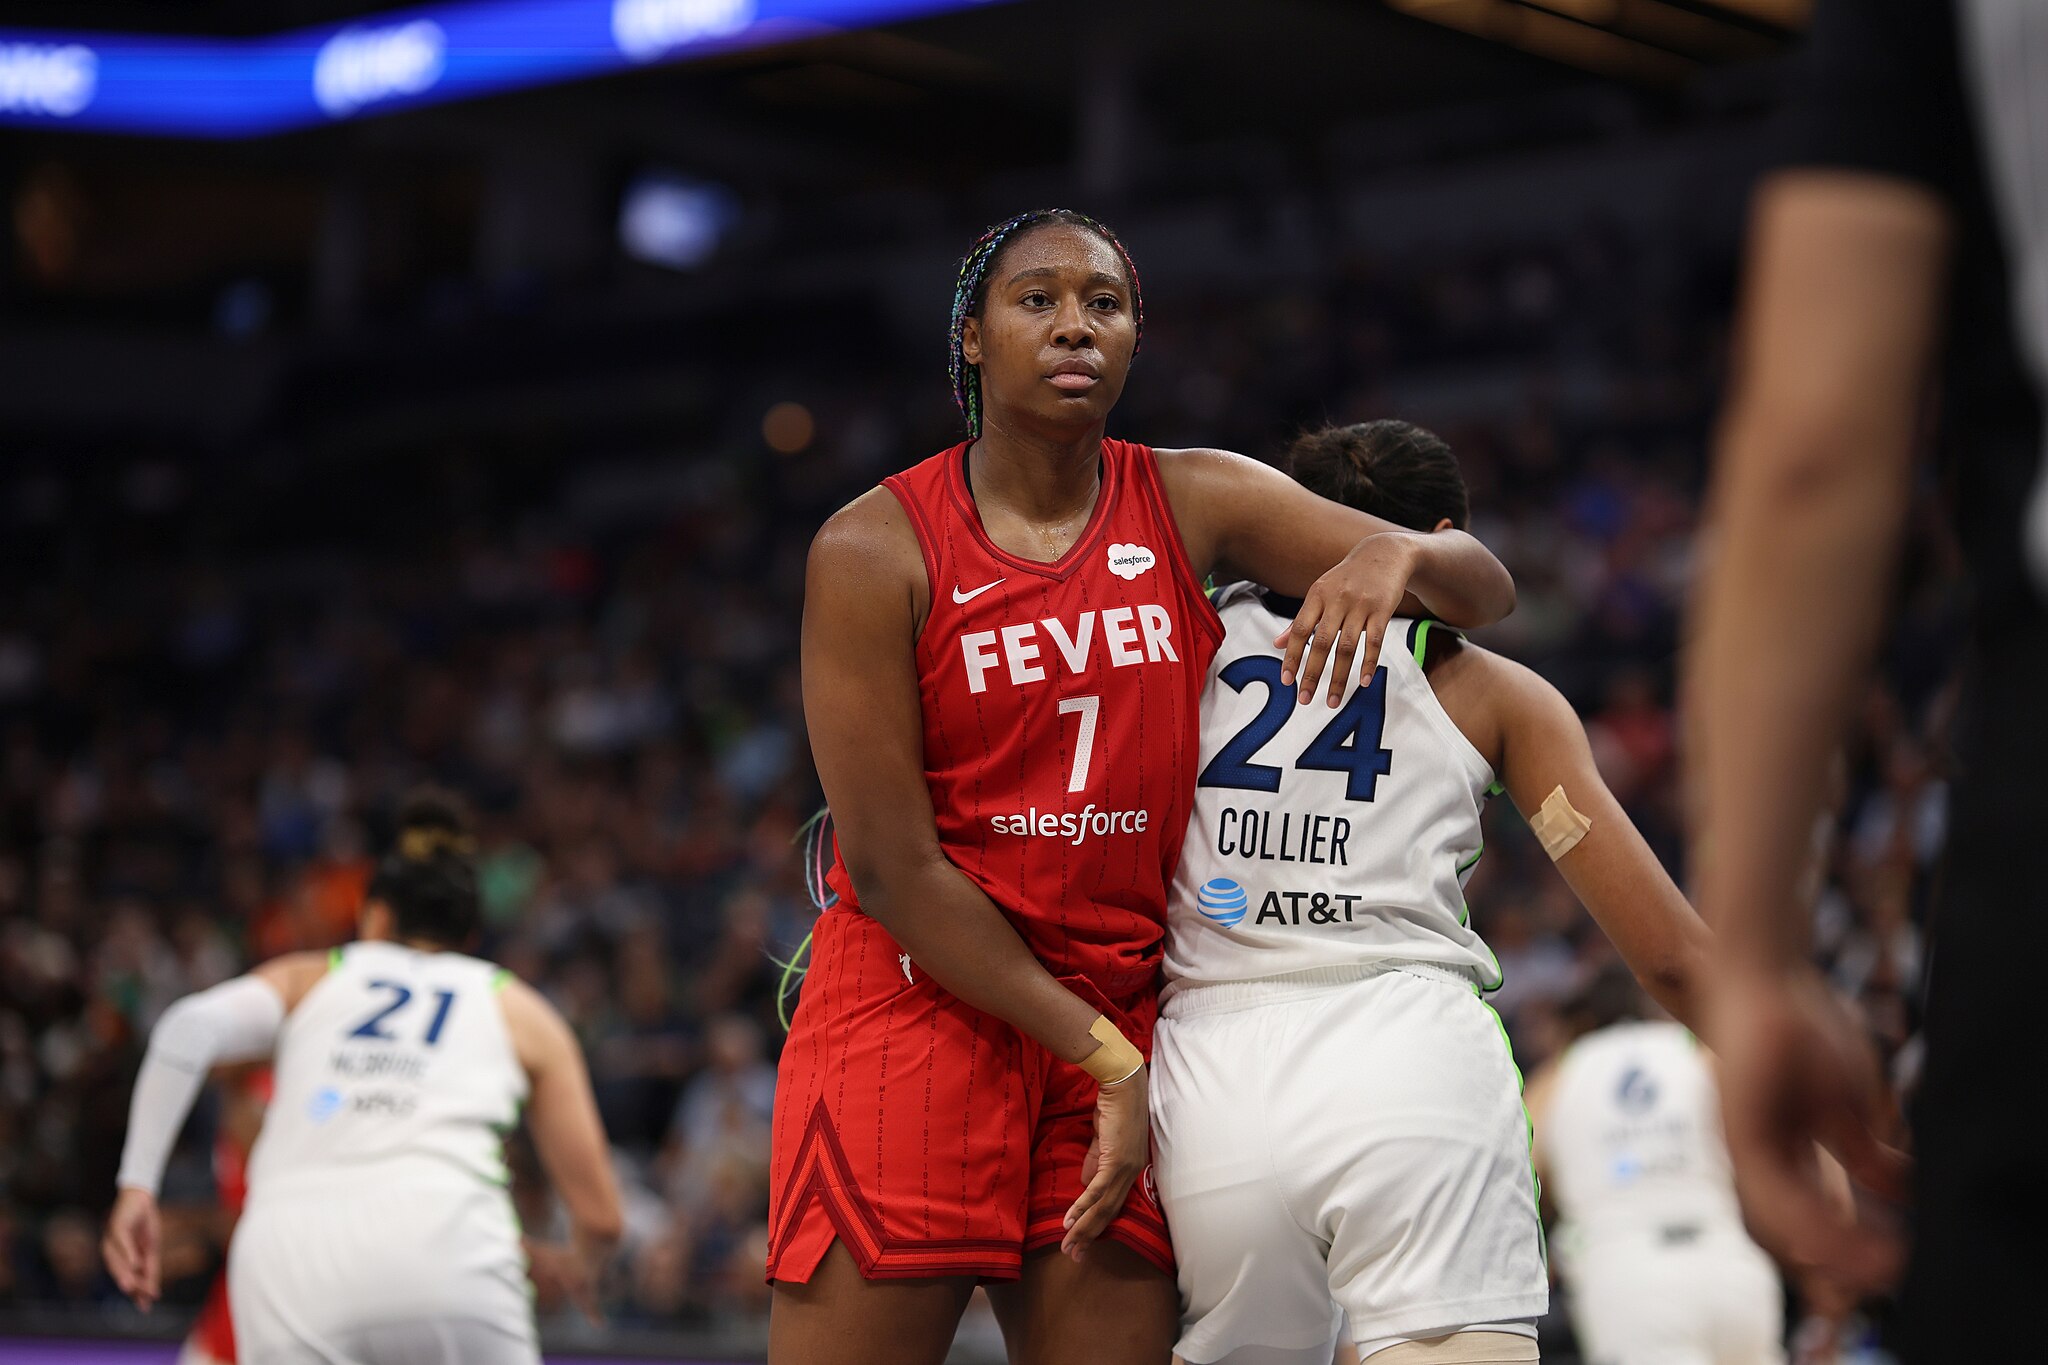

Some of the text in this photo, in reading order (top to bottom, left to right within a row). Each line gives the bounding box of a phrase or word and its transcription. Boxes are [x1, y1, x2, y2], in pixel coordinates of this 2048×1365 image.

[1113, 555, 1151, 567] salesforce
[960, 604, 1180, 694] FEVER
[1057, 693, 1100, 794] 7
[1197, 655, 1393, 803] 24
[990, 804, 1149, 846] salesforce
[1217, 807, 1351, 866] COLLIER
[1255, 890, 1363, 925] AT&T
[346, 978, 456, 1046] 21
